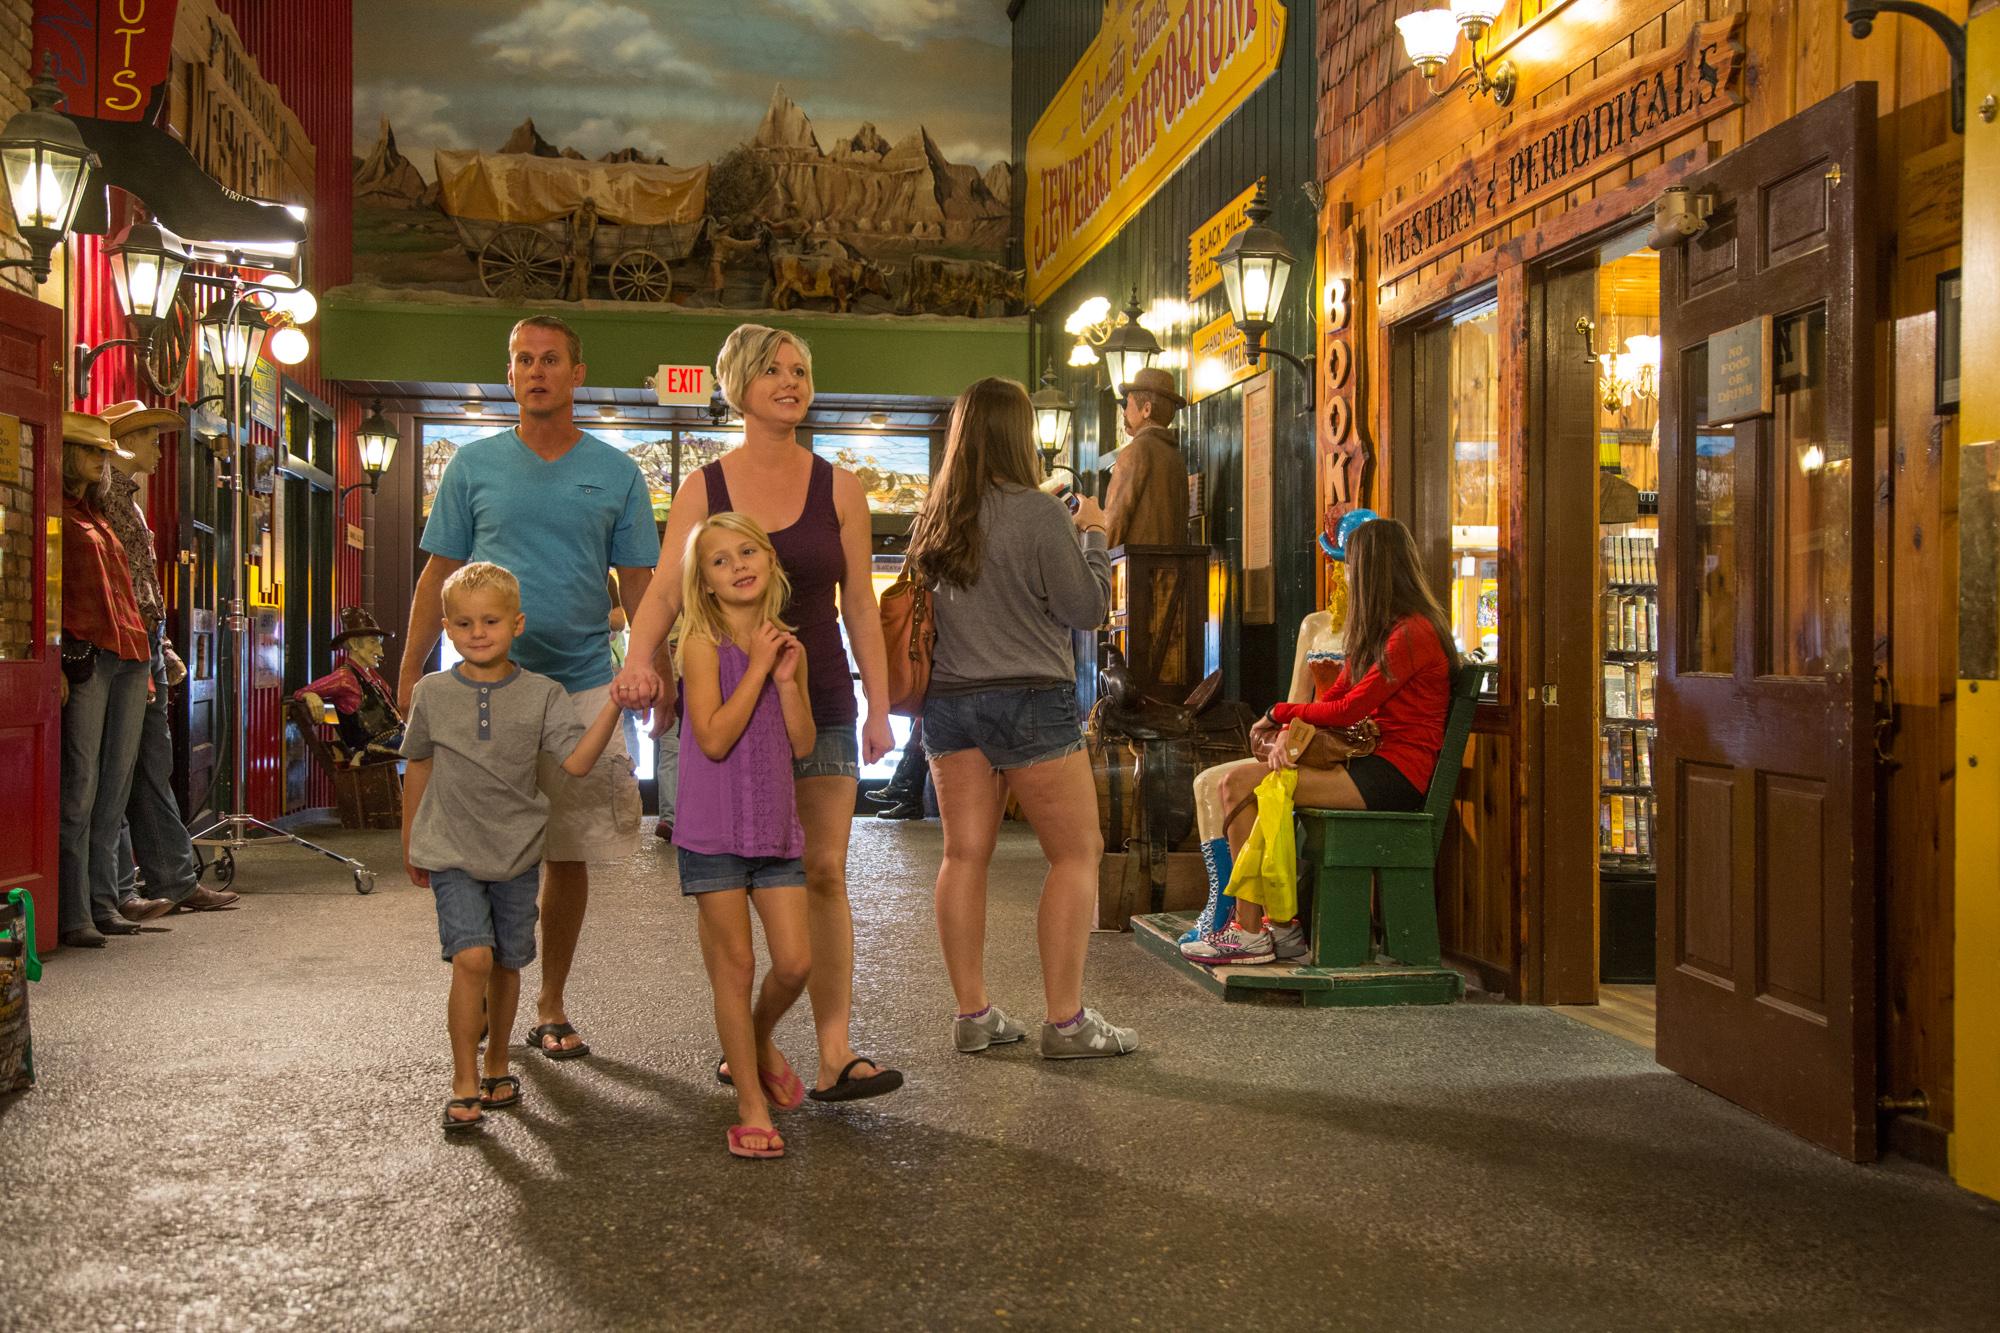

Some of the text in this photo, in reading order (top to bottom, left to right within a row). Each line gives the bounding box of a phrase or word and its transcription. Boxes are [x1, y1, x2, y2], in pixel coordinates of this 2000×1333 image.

[1383, 42, 1719, 272] WESTERN & PERIODICALS
[1034, 122, 1115, 272] JEWELRY
[1200, 202, 1248, 257] BLACK HILLS
[1194, 256, 1214, 286] GOLD
[1221, 339, 1248, 372] JEWELR
[1720, 356, 1751, 375] FOOD
[1727, 345, 1743, 359] NO
[668, 367, 704, 393] EXIT
[1718, 383, 1753, 403] DRINK
[1727, 373, 1745, 386] OR
